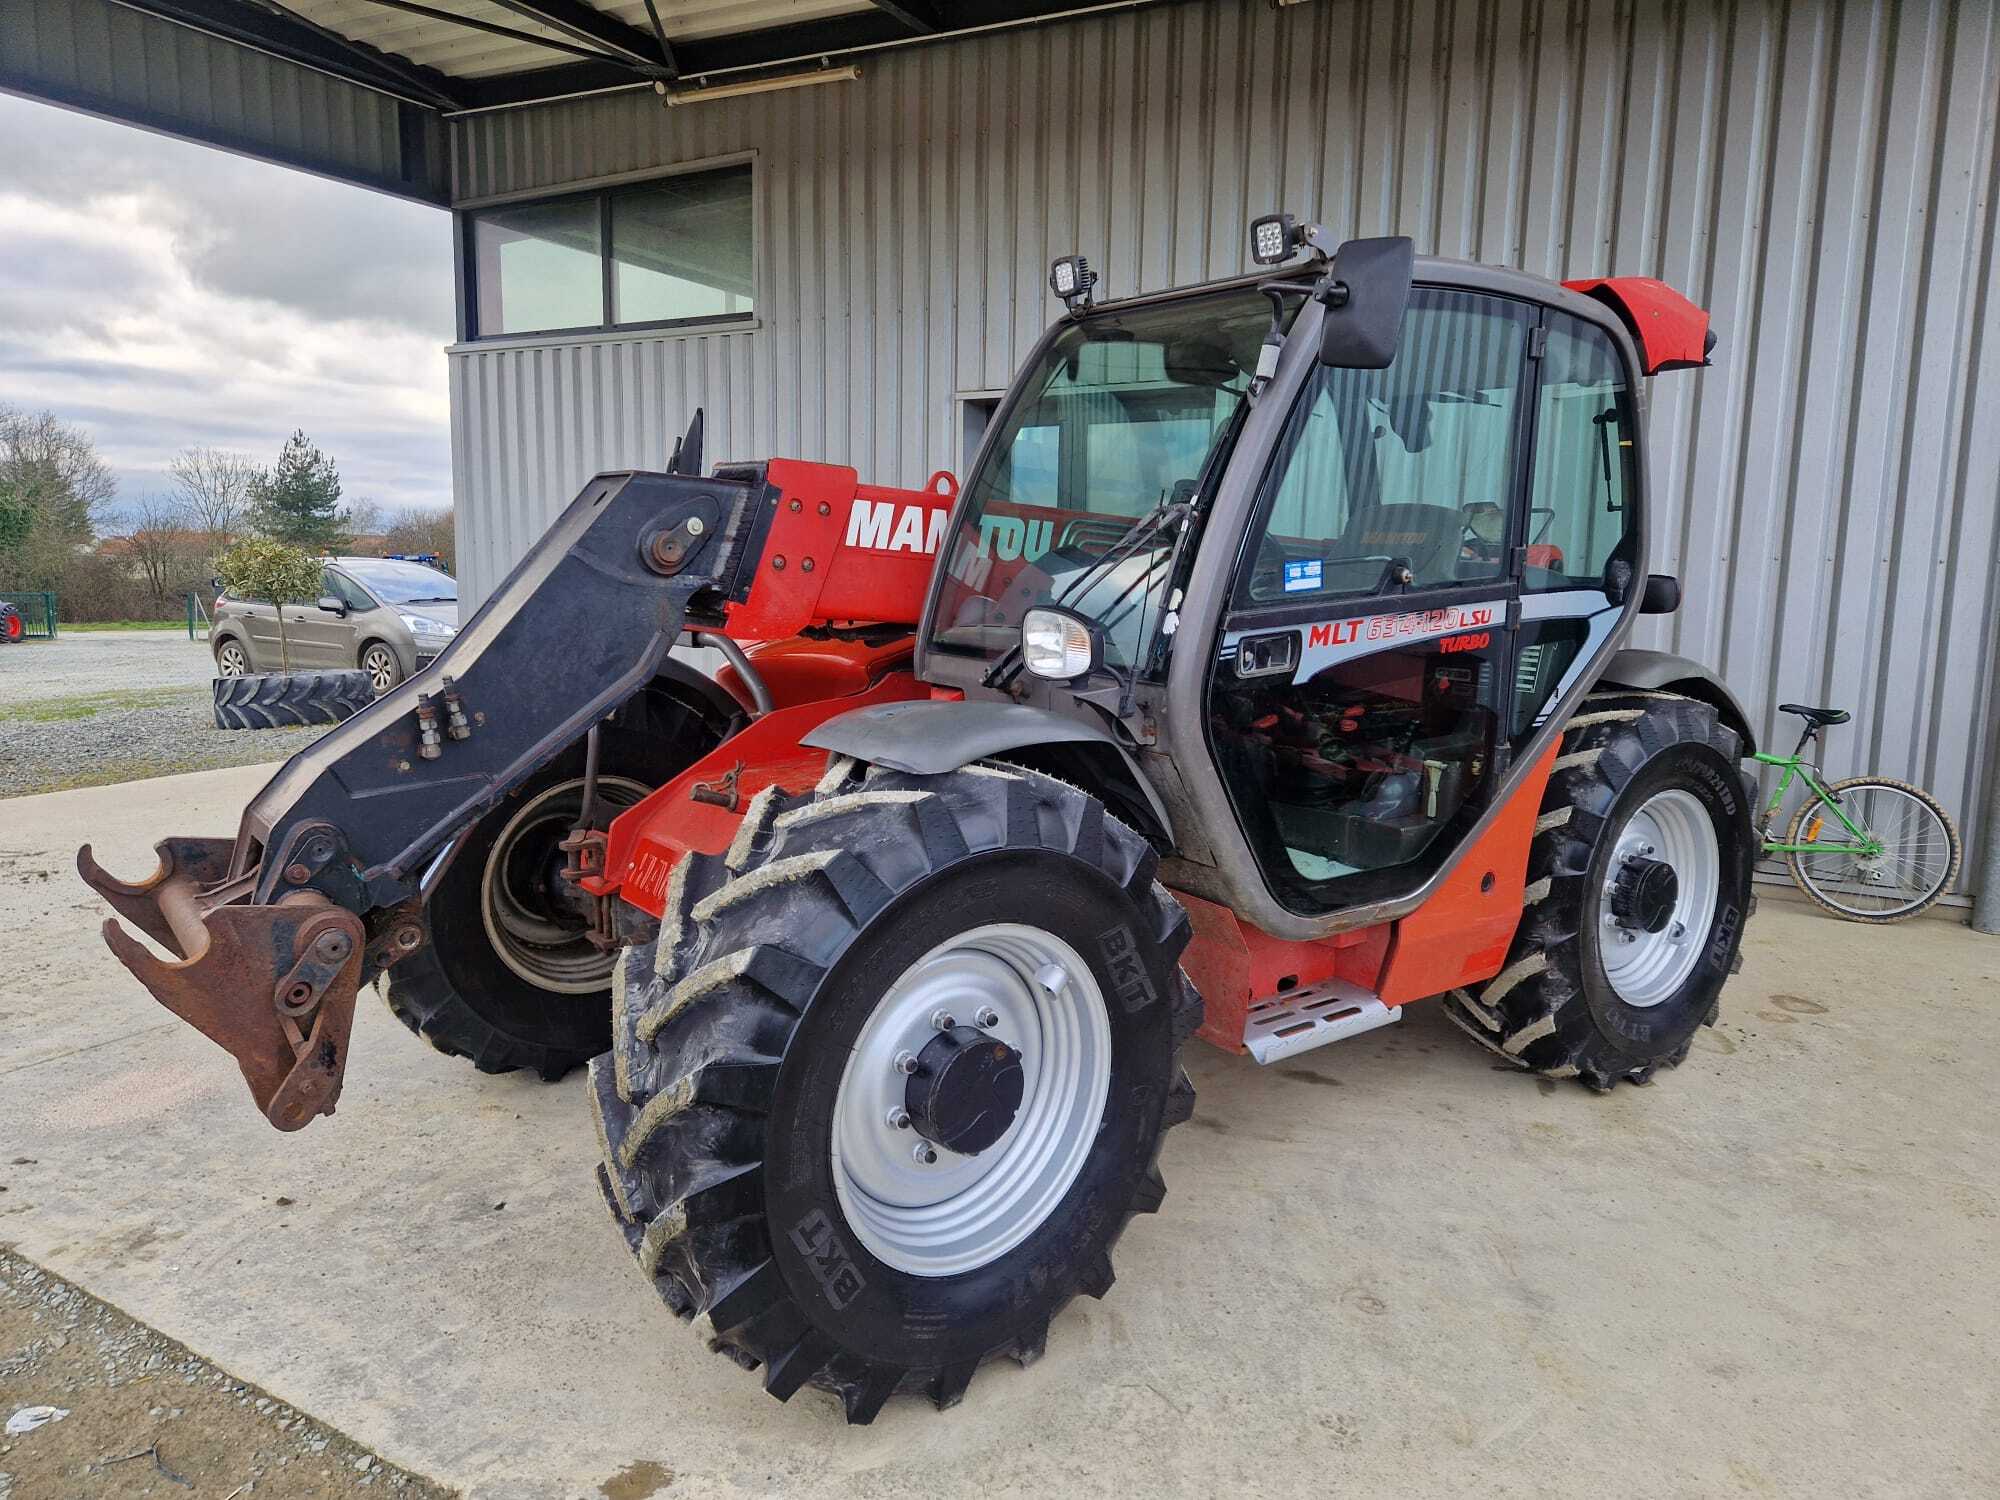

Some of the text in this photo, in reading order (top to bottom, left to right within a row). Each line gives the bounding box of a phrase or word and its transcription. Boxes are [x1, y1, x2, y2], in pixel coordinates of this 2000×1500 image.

[844, 499, 1054, 563] MANTOU
[1308, 619, 1365, 649] MLT
[1459, 609, 1492, 628] LSU
[1439, 632, 1491, 654] TURBO
[1101, 927, 1154, 1007] BKT
[1714, 906, 1739, 970] BKT
[794, 1214, 862, 1306] BKT
